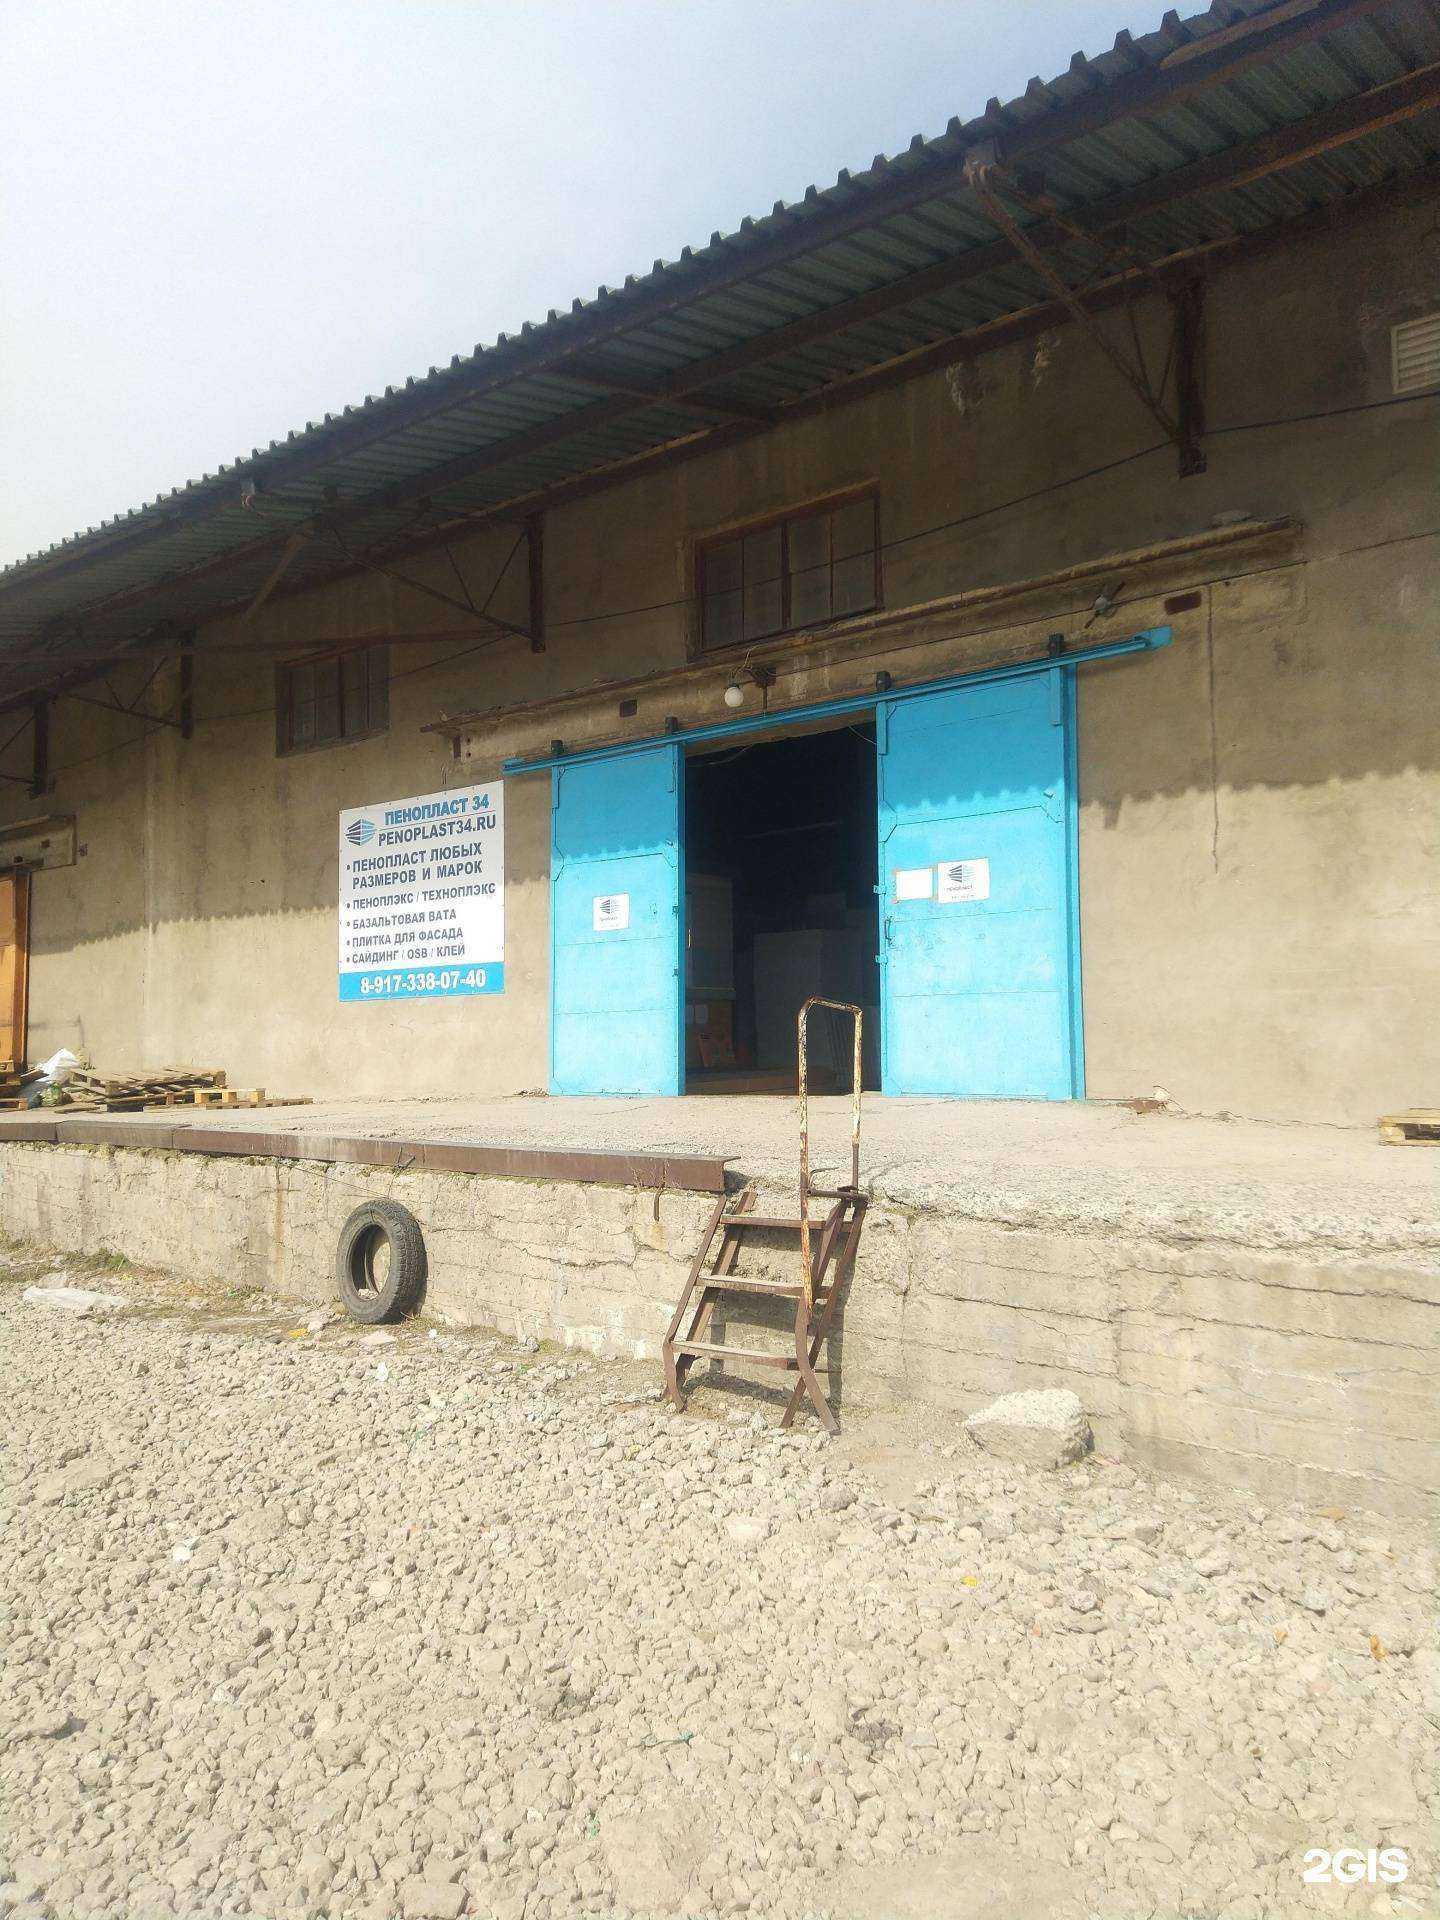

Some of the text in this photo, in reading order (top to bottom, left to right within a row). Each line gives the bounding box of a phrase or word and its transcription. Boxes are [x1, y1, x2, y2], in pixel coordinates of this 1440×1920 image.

[384, 794, 489, 825] ПЕНОПЛАСТ 34
[378, 814, 496, 846] PENOPLAST34.RU
[353, 842, 482, 872] ПЕНОПЛАСТ ЛЮБЫХ
[353, 860, 482, 889] РАЗМЕРОВ И МАРОК
[353, 893, 414, 909] ПЕНОПЛЭКС
[422, 883, 496, 901] ТЕХНОПЛЭКС
[353, 909, 456, 929] БАЗАЛЬТОВАЯ ВАТА
[353, 928, 463, 947] ПЛИТКА ДЛЯ ФАСАДА
[352, 950, 398, 964] САЙДИНГ
[407, 948, 428, 959] OSB
[437, 944, 465, 957] КЛЕЙ
[360, 968, 486, 993] 8-917-338-07-40
